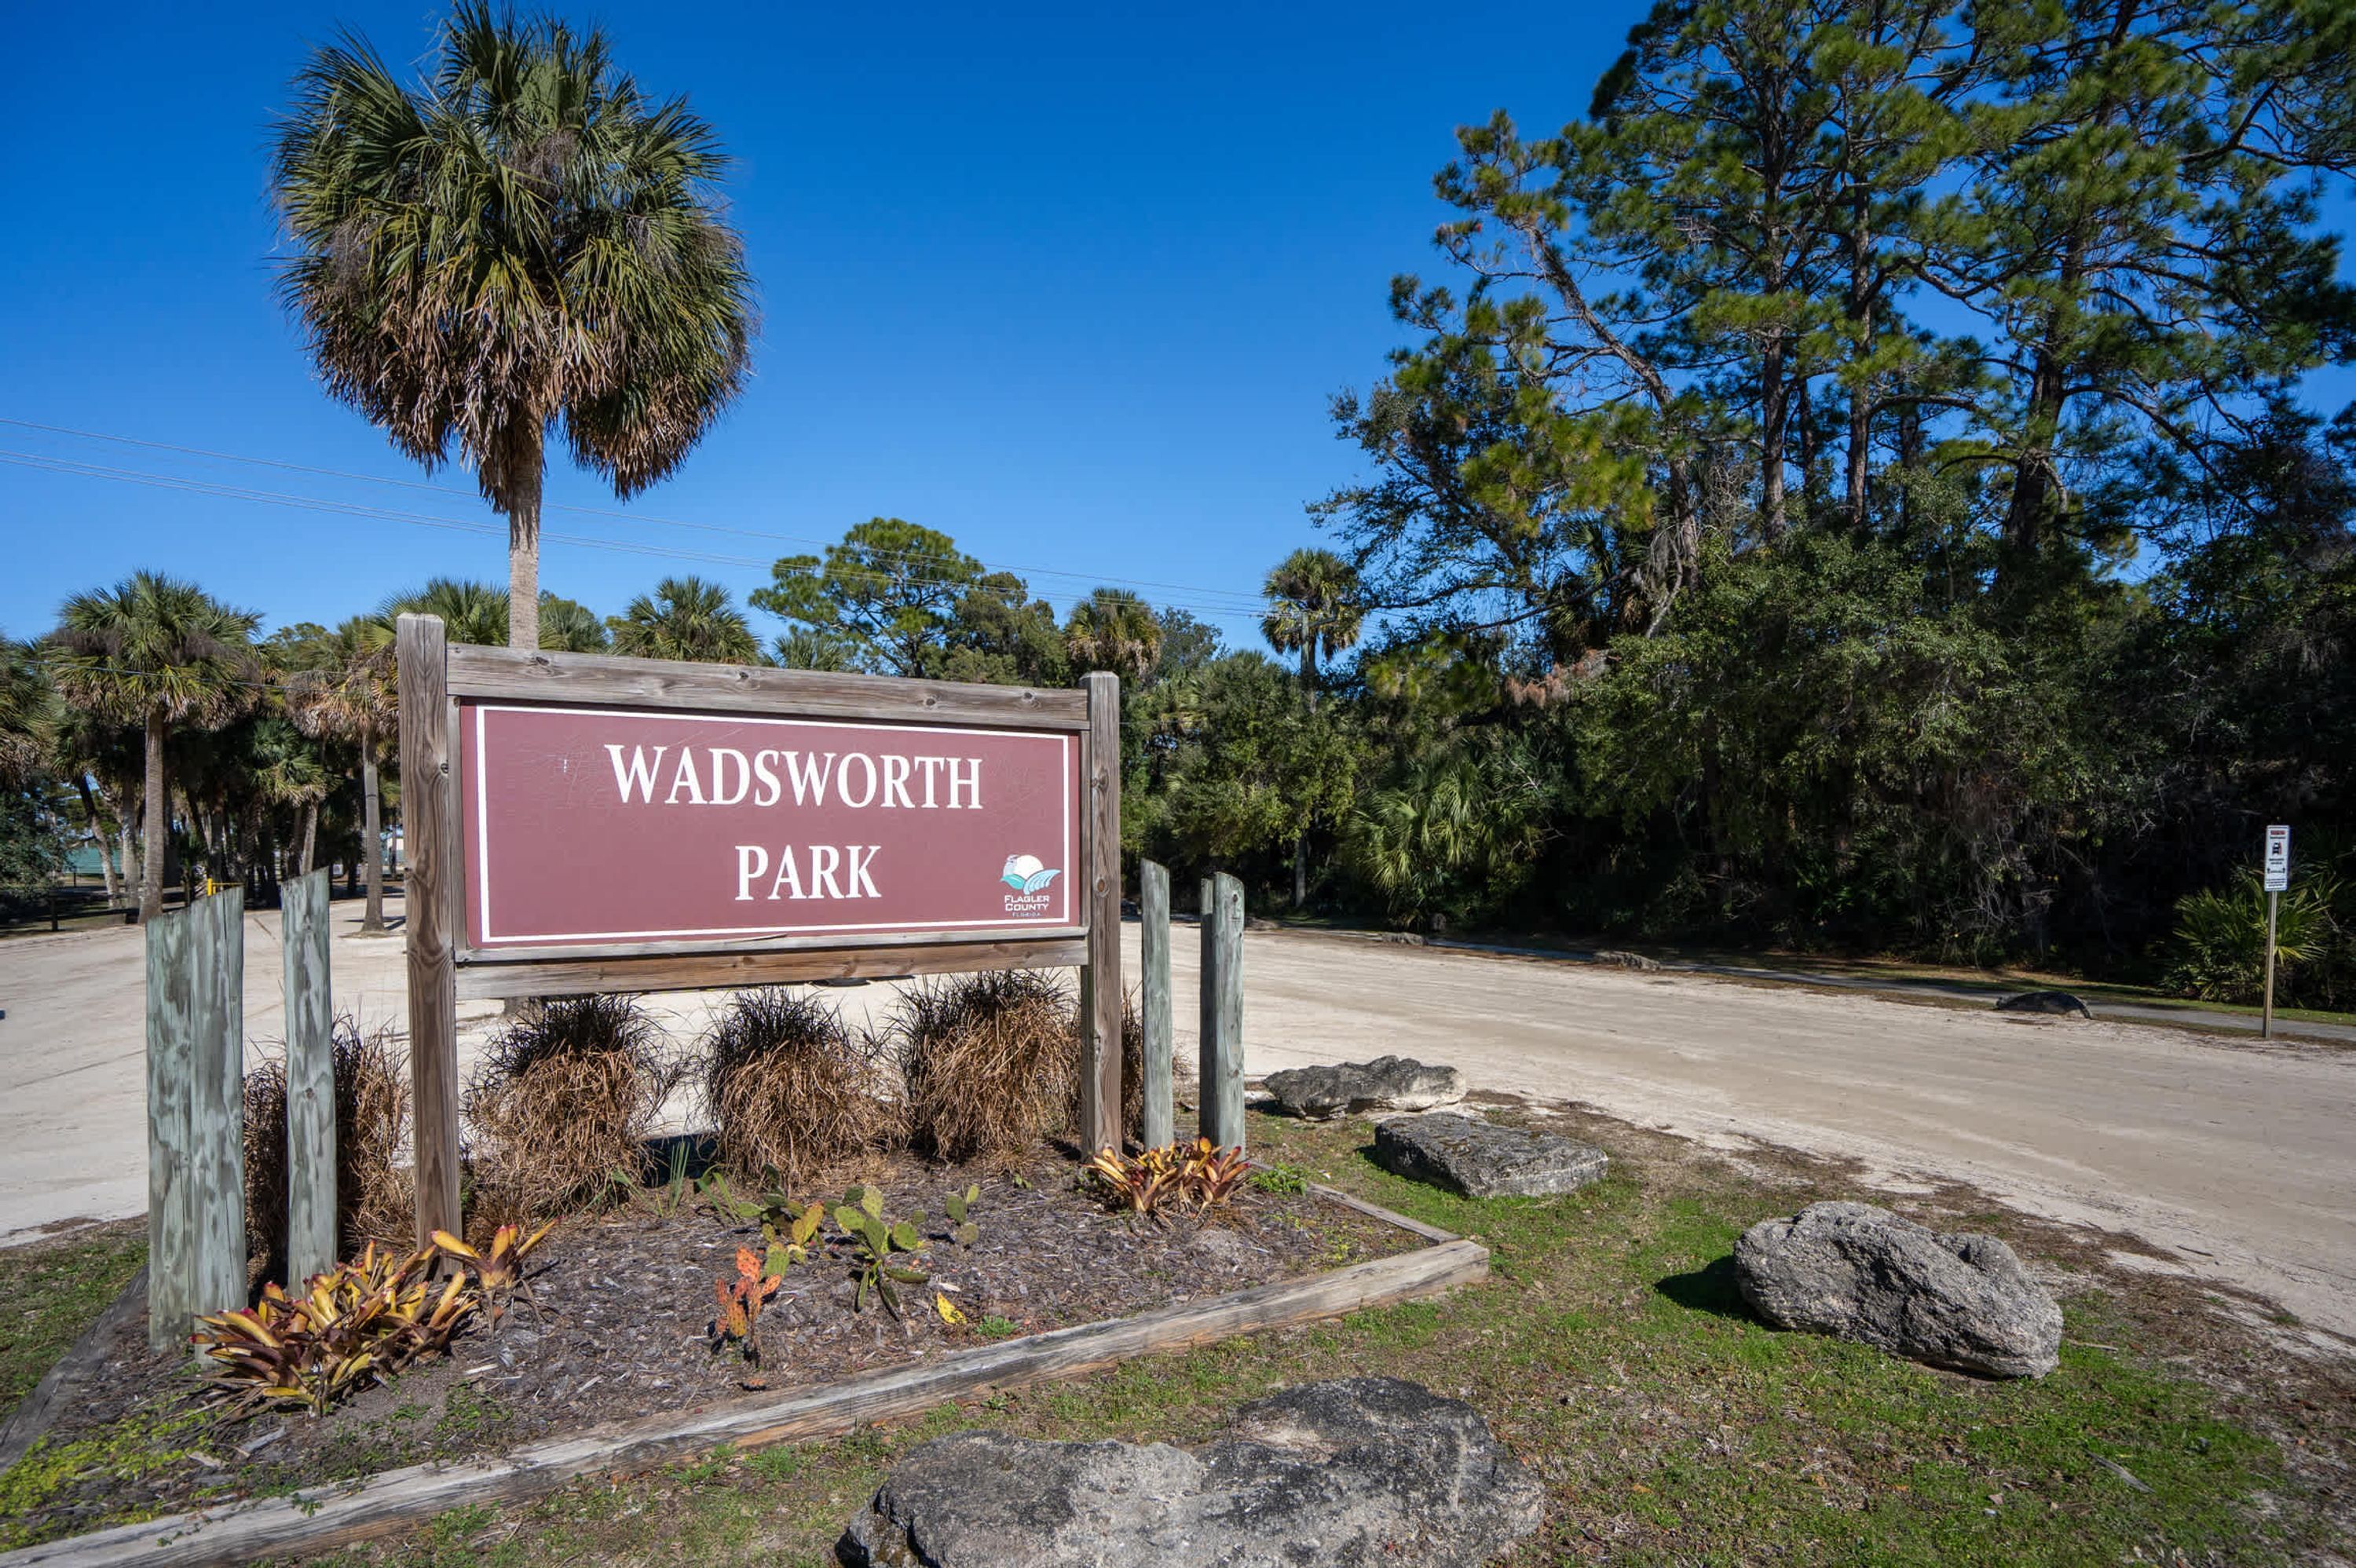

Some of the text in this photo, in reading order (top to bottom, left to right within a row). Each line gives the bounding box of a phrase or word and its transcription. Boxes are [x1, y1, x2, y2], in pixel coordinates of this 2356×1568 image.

[604, 744, 983, 809] WADSWORTH
[735, 845, 882, 901] PARK
[1005, 903, 1049, 912] COUNTY
